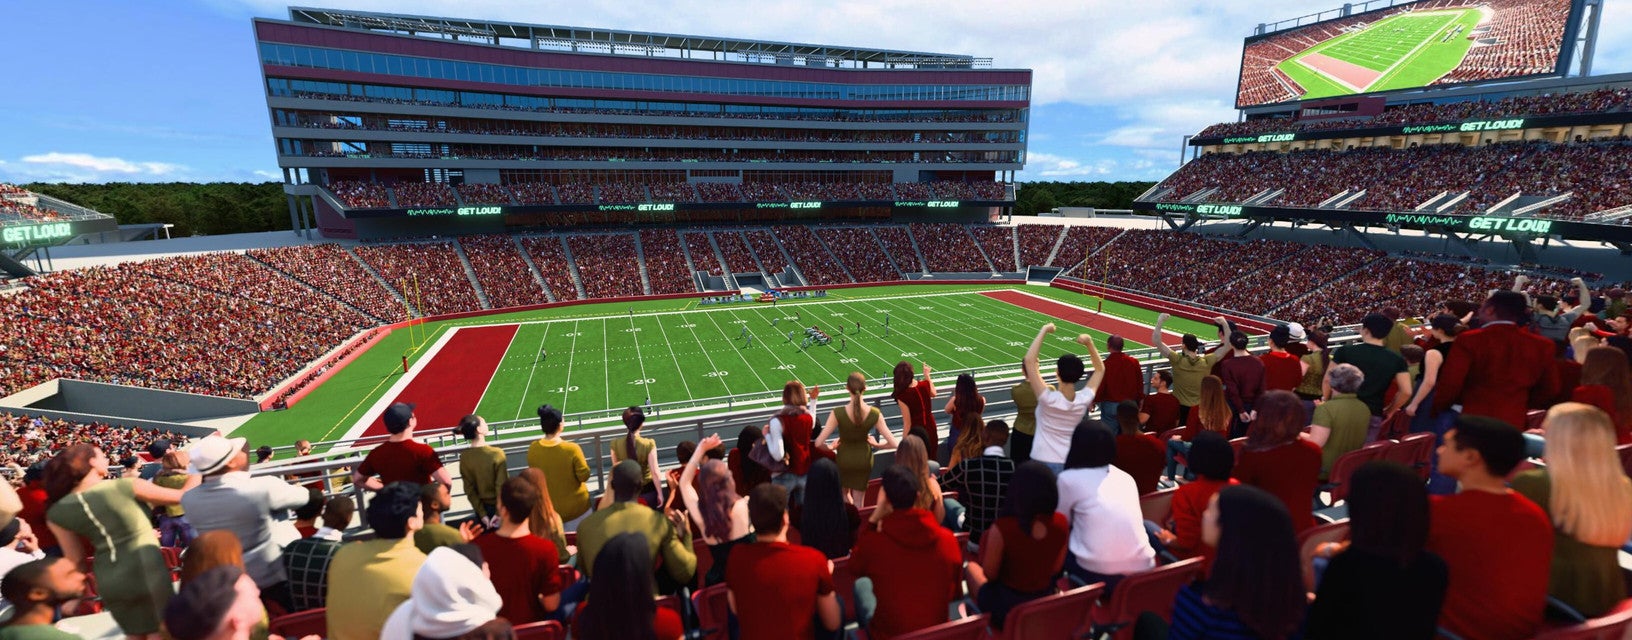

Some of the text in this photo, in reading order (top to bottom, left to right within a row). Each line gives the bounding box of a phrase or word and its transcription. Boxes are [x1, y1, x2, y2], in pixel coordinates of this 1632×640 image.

[1460, 119, 1524, 131] GET LOUD!
[457, 207, 502, 215] GET LOUD!
[1197, 205, 1242, 215] GET LOUD!
[1469, 217, 1551, 233] GET LOUD!
[3, 223, 71, 242] GET LOUD!
